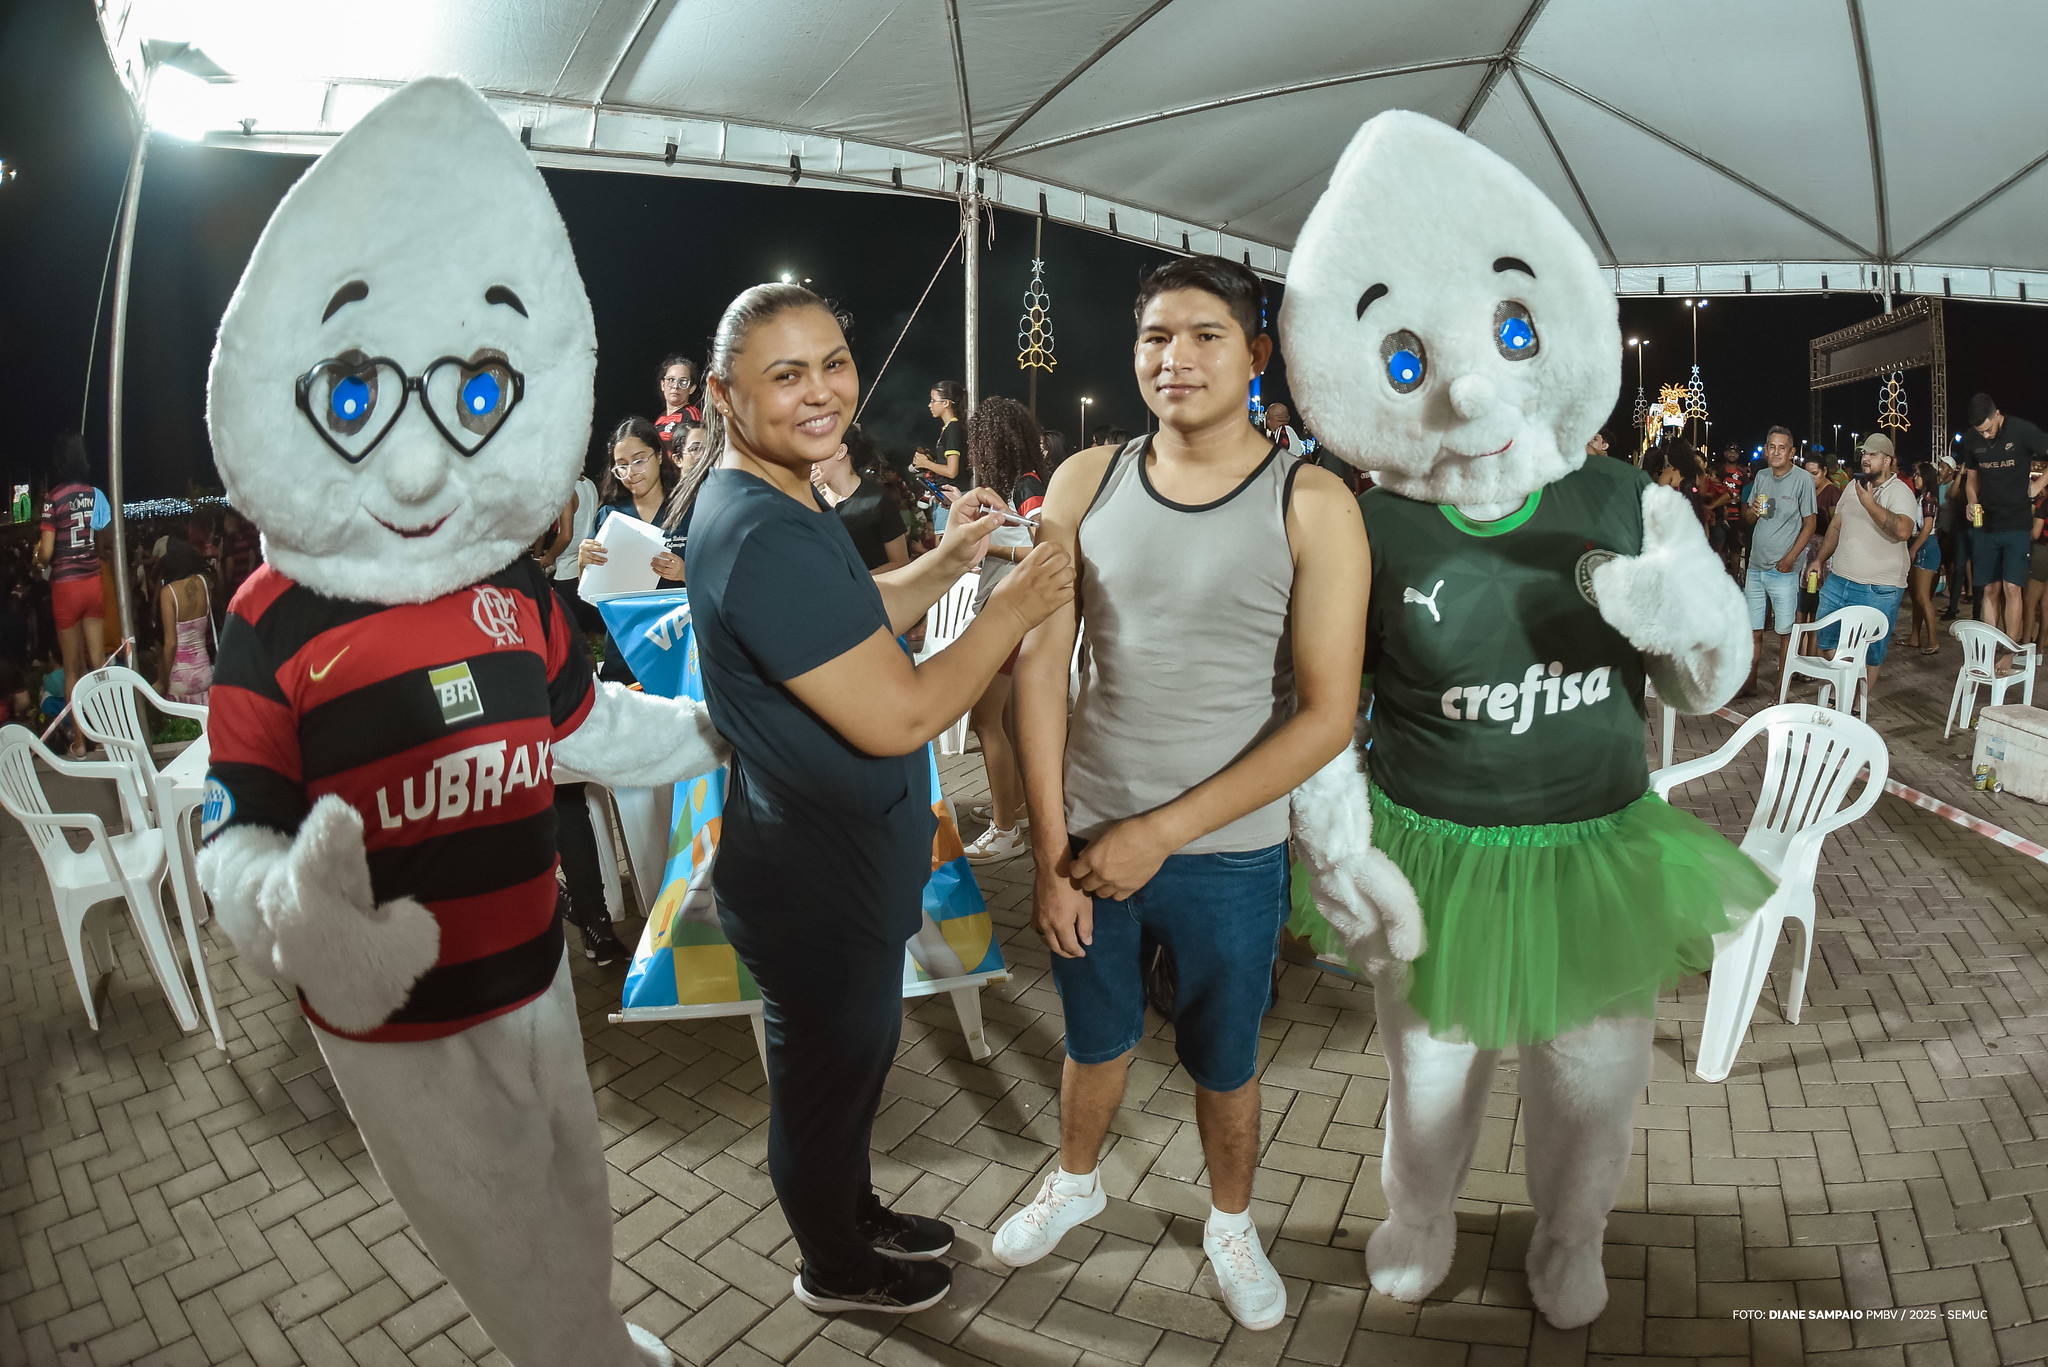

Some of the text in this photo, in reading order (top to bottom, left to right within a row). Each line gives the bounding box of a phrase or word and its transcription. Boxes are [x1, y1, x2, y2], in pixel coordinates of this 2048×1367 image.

[2000, 459, 2015, 468] AIR
[440, 679, 475, 708] BR
[1440, 660, 1612, 735] crefisa
[375, 738, 550, 830] LUBRAX
